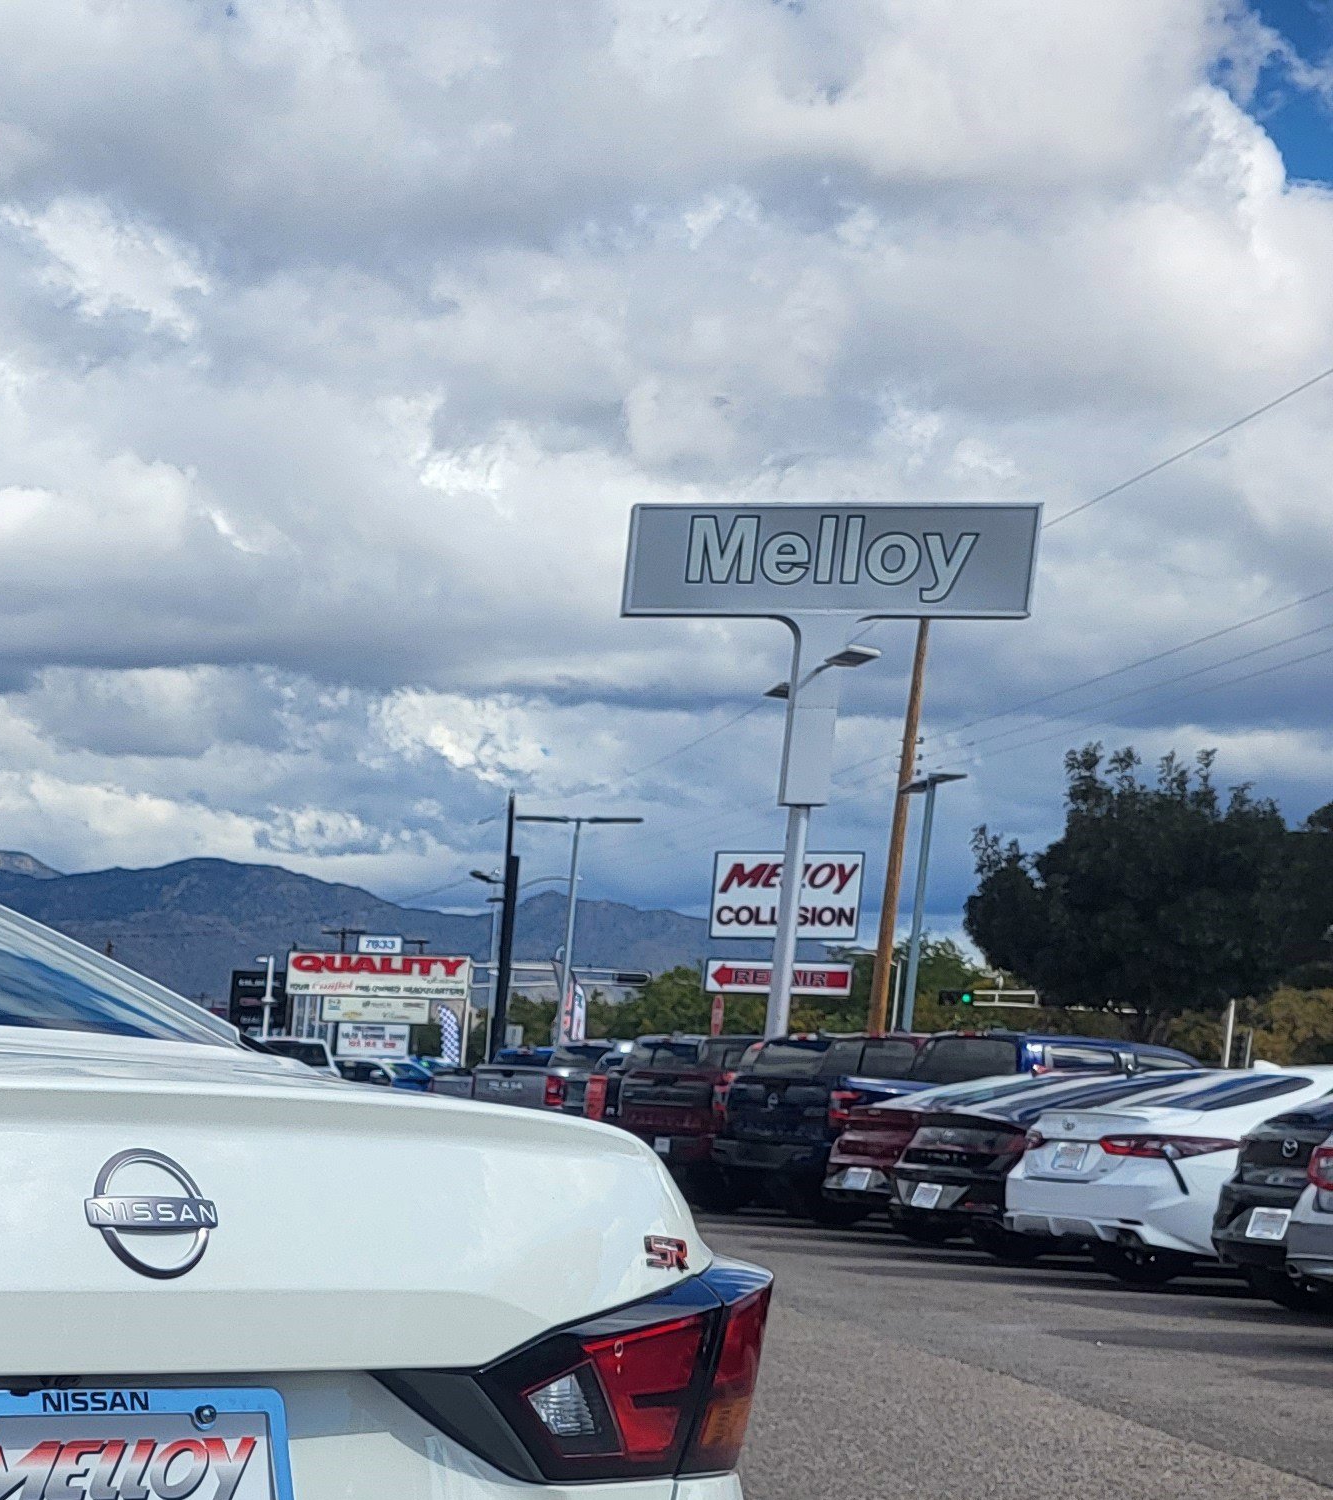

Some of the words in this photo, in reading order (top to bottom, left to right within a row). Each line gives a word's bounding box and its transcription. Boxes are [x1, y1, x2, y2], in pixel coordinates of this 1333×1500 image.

[684, 514, 979, 604] Melloy
[719, 863, 860, 895] MEOY
[716, 905, 856, 926] COLLSION
[292, 954, 467, 977] QUALITY
[734, 967, 827, 987] REAIR
[90, 1202, 217, 1223] NISSAN
[643, 1235, 690, 1273] SR
[41, 1391, 150, 1413] NISSAN
